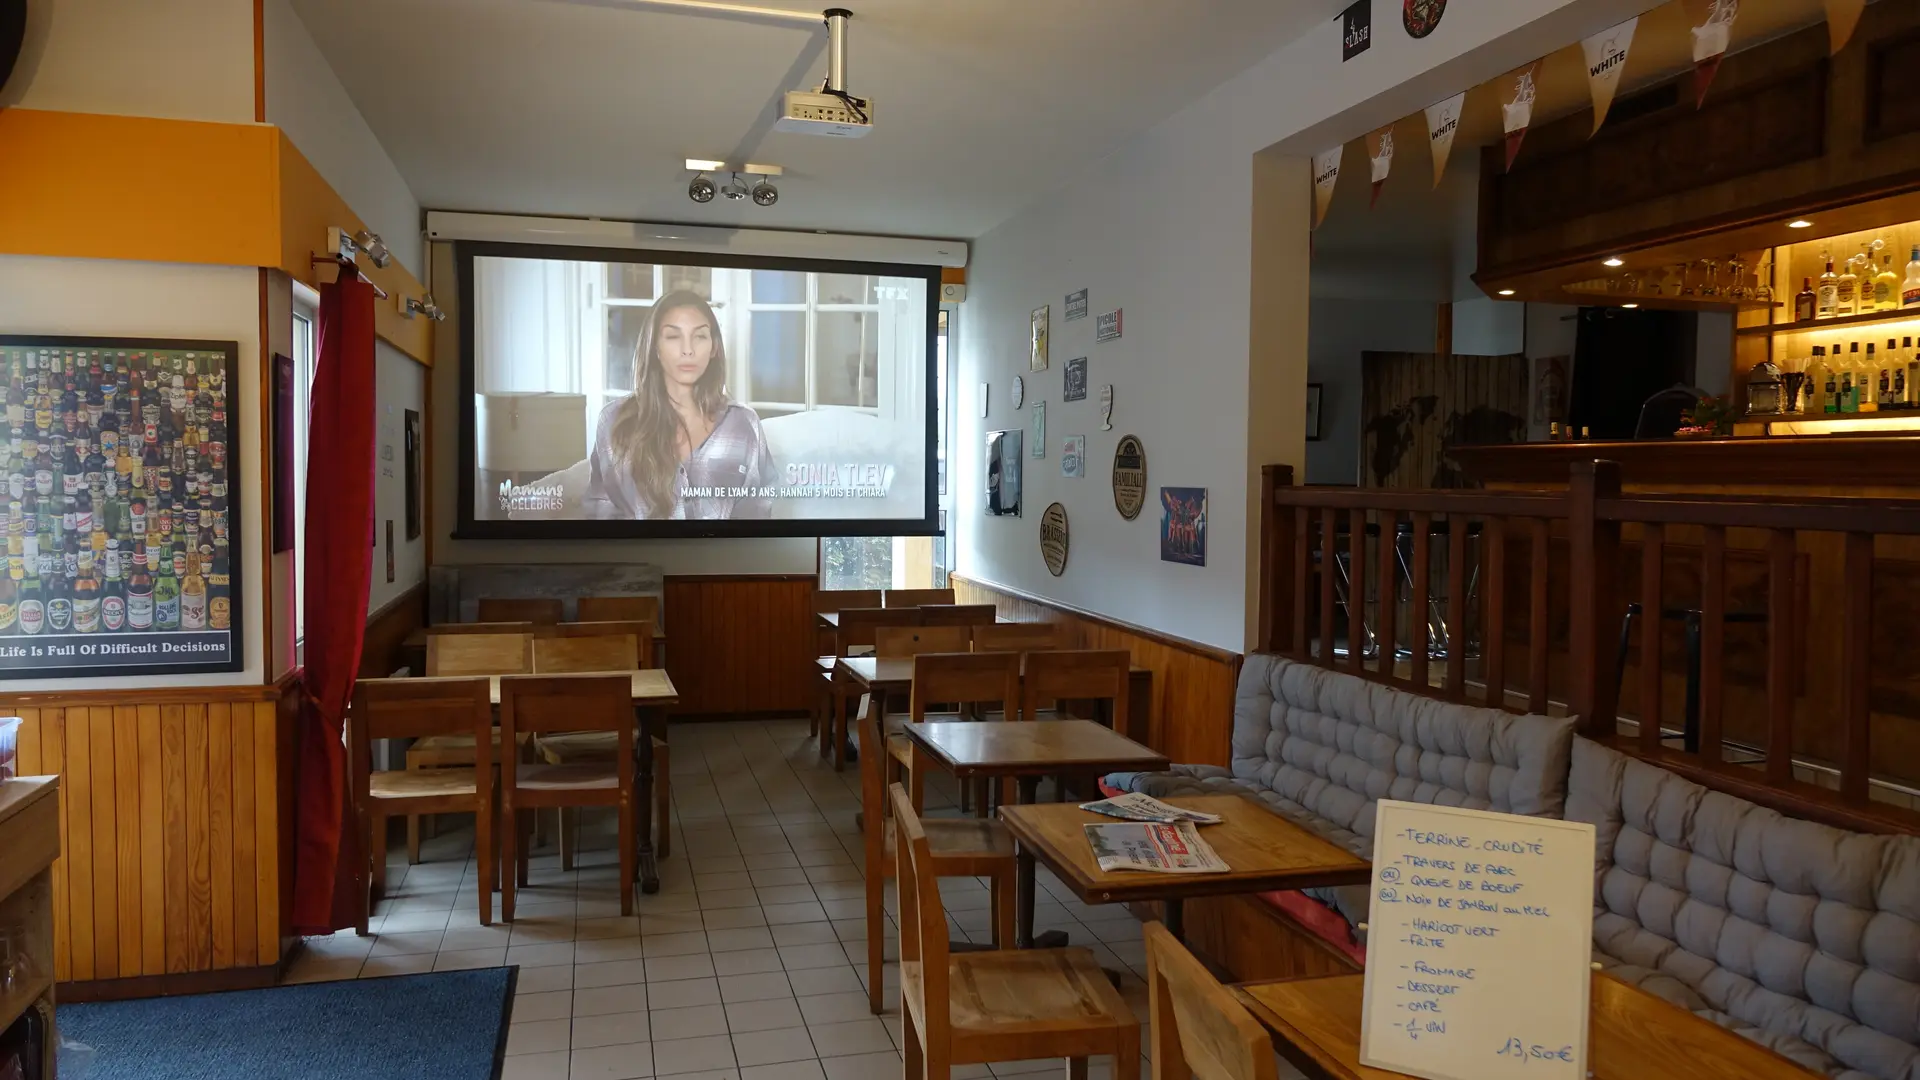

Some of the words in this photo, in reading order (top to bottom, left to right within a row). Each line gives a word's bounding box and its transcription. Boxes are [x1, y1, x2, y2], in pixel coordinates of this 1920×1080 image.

[1345, 25, 1369, 48] SLASH
[1590, 50, 1626, 77] WHITE
[1431, 119, 1457, 141] WHITE
[1316, 167, 1338, 185] WHITE
[873, 286, 910, 300] TFX
[786, 462, 840, 486] SONIA
[844, 463, 887, 487] TLEV
[499, 479, 564, 498] Mamans
[681, 487, 712, 498] MAMAN
[715, 487, 726, 498] DE
[728, 487, 749, 498] LYAM
[751, 487, 757, 498] 3
[759, 487, 778, 498] ANS,
[780, 487, 813, 498] HANNAH
[816, 487, 821, 498] 5
[824, 487, 844, 498] MOIS
[846, 487, 856, 498] ET
[858, 487, 886, 498] CHIARA
[0, 646, 27, 657] Life
[31, 646, 43, 657] Is
[47, 645, 76, 656] Full
[80, 644, 97, 655] Of
[100, 642, 158, 654] Difficult
[162, 641, 226, 653] Decisions
[1402, 854, 1456, 871] TRAVERS
[1464, 863, 1482, 875] DE
[1410, 875, 1453, 889] QUEUE
[1458, 879, 1474, 891] DE
[1481, 880, 1524, 894] BOEUF
[1438, 898, 1451, 909] DE
[1465, 925, 1500, 937] VERT
[1414, 960, 1476, 980] FROMAGE
[1407, 980, 1460, 995] DESSERT
